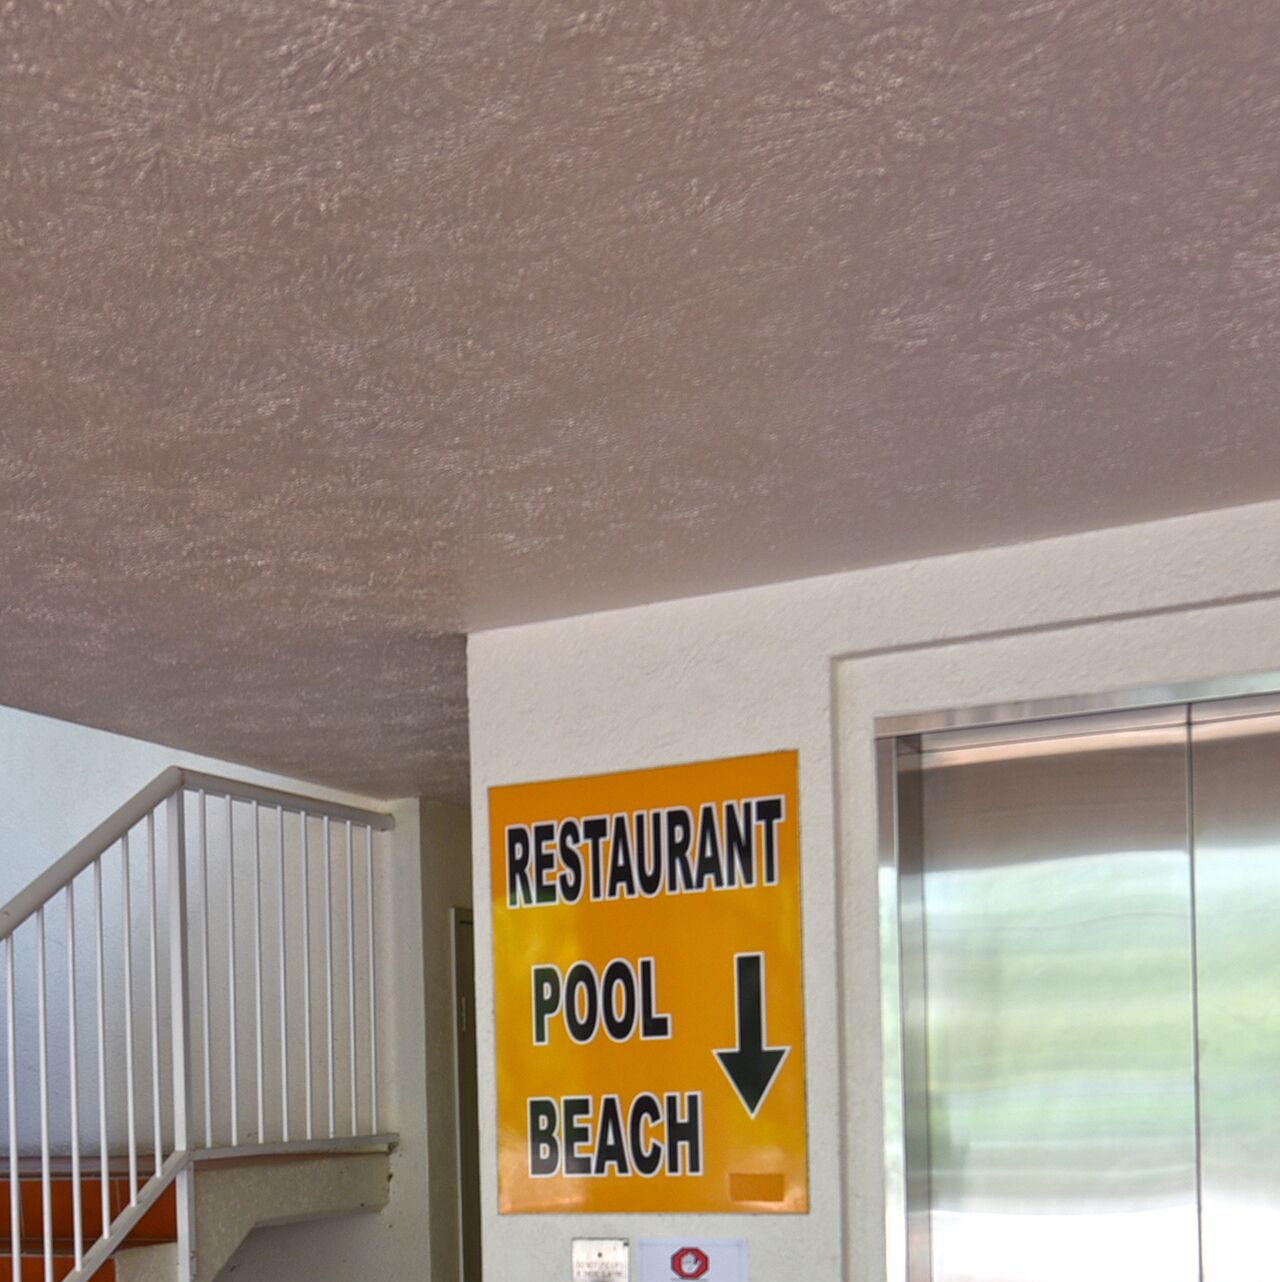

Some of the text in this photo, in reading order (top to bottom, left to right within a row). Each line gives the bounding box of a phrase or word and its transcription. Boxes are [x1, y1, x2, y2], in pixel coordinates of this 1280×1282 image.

[506, 796, 785, 908] RESTAURANT
[531, 957, 672, 1046] POOL
[528, 1091, 704, 1177] BEACH
